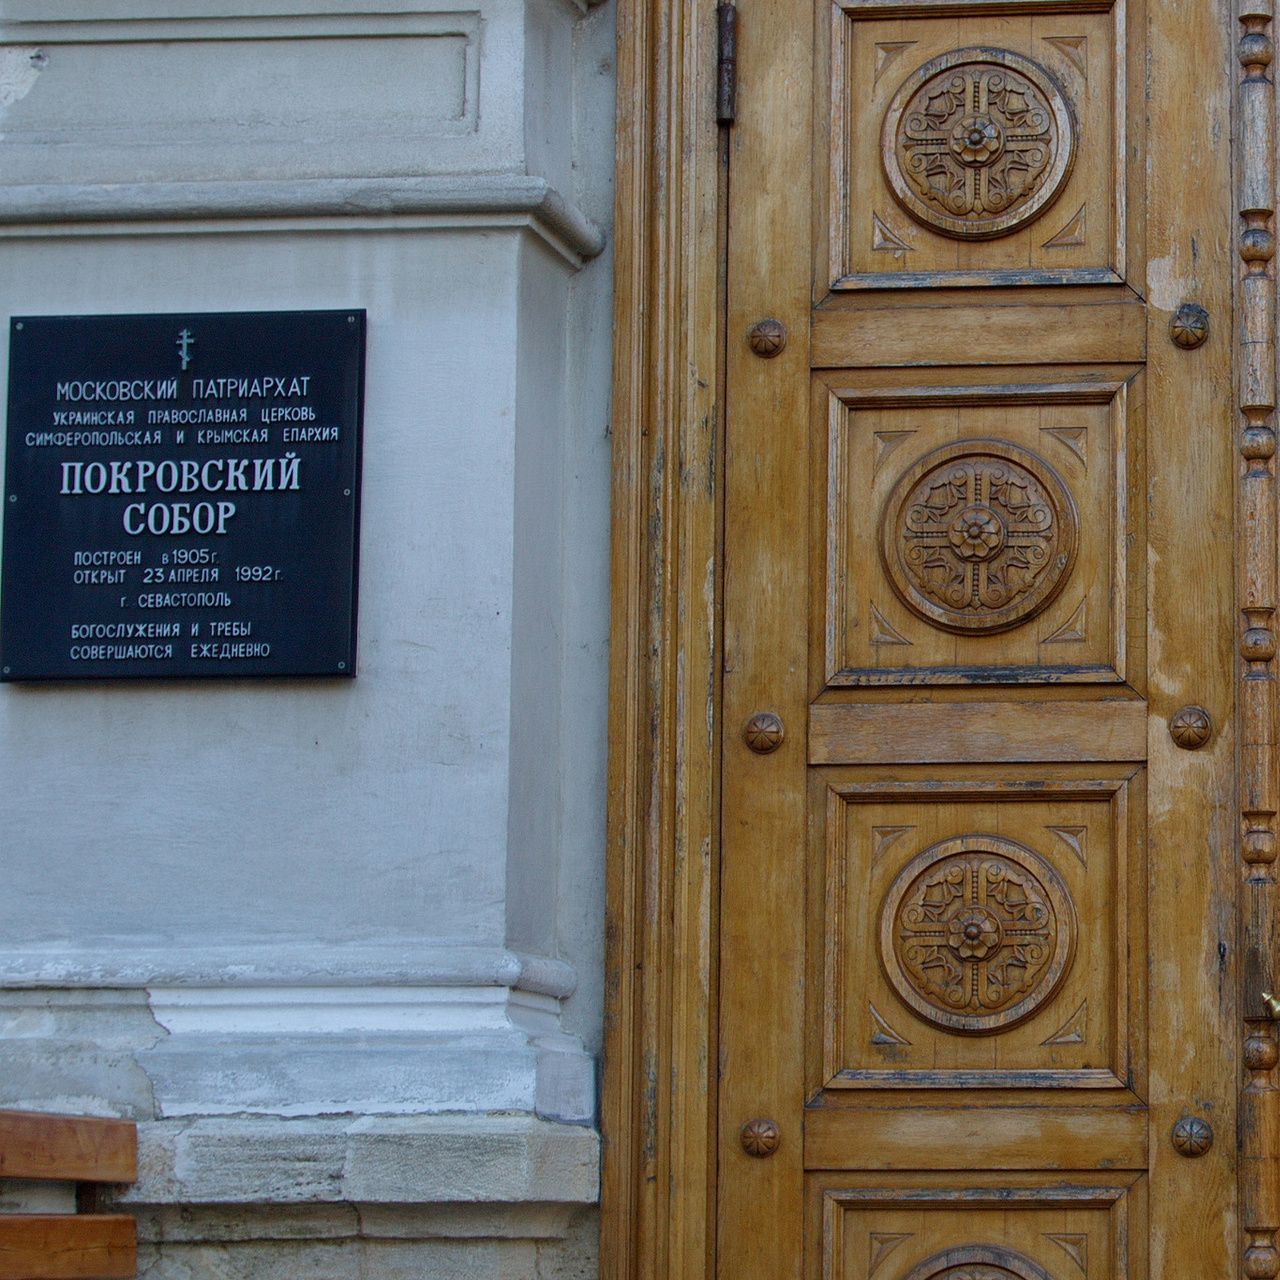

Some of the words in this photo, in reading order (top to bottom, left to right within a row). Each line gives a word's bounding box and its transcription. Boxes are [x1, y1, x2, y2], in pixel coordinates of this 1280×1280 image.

[57, 377, 177, 401] МОСКОВСКИЙ
[192, 376, 310, 398] ПАТРИАРХАТ
[53, 410, 134, 425] УКРАИНСКАЯ
[148, 408, 247, 424] ПРАВОСЛАВНАЯ
[261, 408, 316, 423] ЦЕРКОВЬ
[25, 430, 161, 447] СИМФЕРОПОЛЬСКАЯ
[176, 431, 184, 444] И
[197, 428, 268, 444] КРЫМСКАЯ
[283, 427, 338, 442] ЕПАРХИЯ
[60, 452, 301, 494] ПОКРОВСКИЙ
[123, 502, 236, 536] СОБОР
[74, 551, 141, 566] ПОСТРОЕН
[74, 569, 125, 584] ОТКРЫТ
[143, 569, 164, 583] 23
[168, 568, 219, 583] АПРЕЛЯ
[138, 593, 231, 608] СЕВАСТОПОЛЬ
[71, 623, 180, 638] БОГОСЛУЖЕНИЯ
[191, 623, 199, 636] И
[210, 622, 251, 636] ТРЕБЫ
[70, 644, 173, 659] СОВЕРШАЮТСЯ
[191, 643, 270, 658] ЕЖЕДНЕВНО
